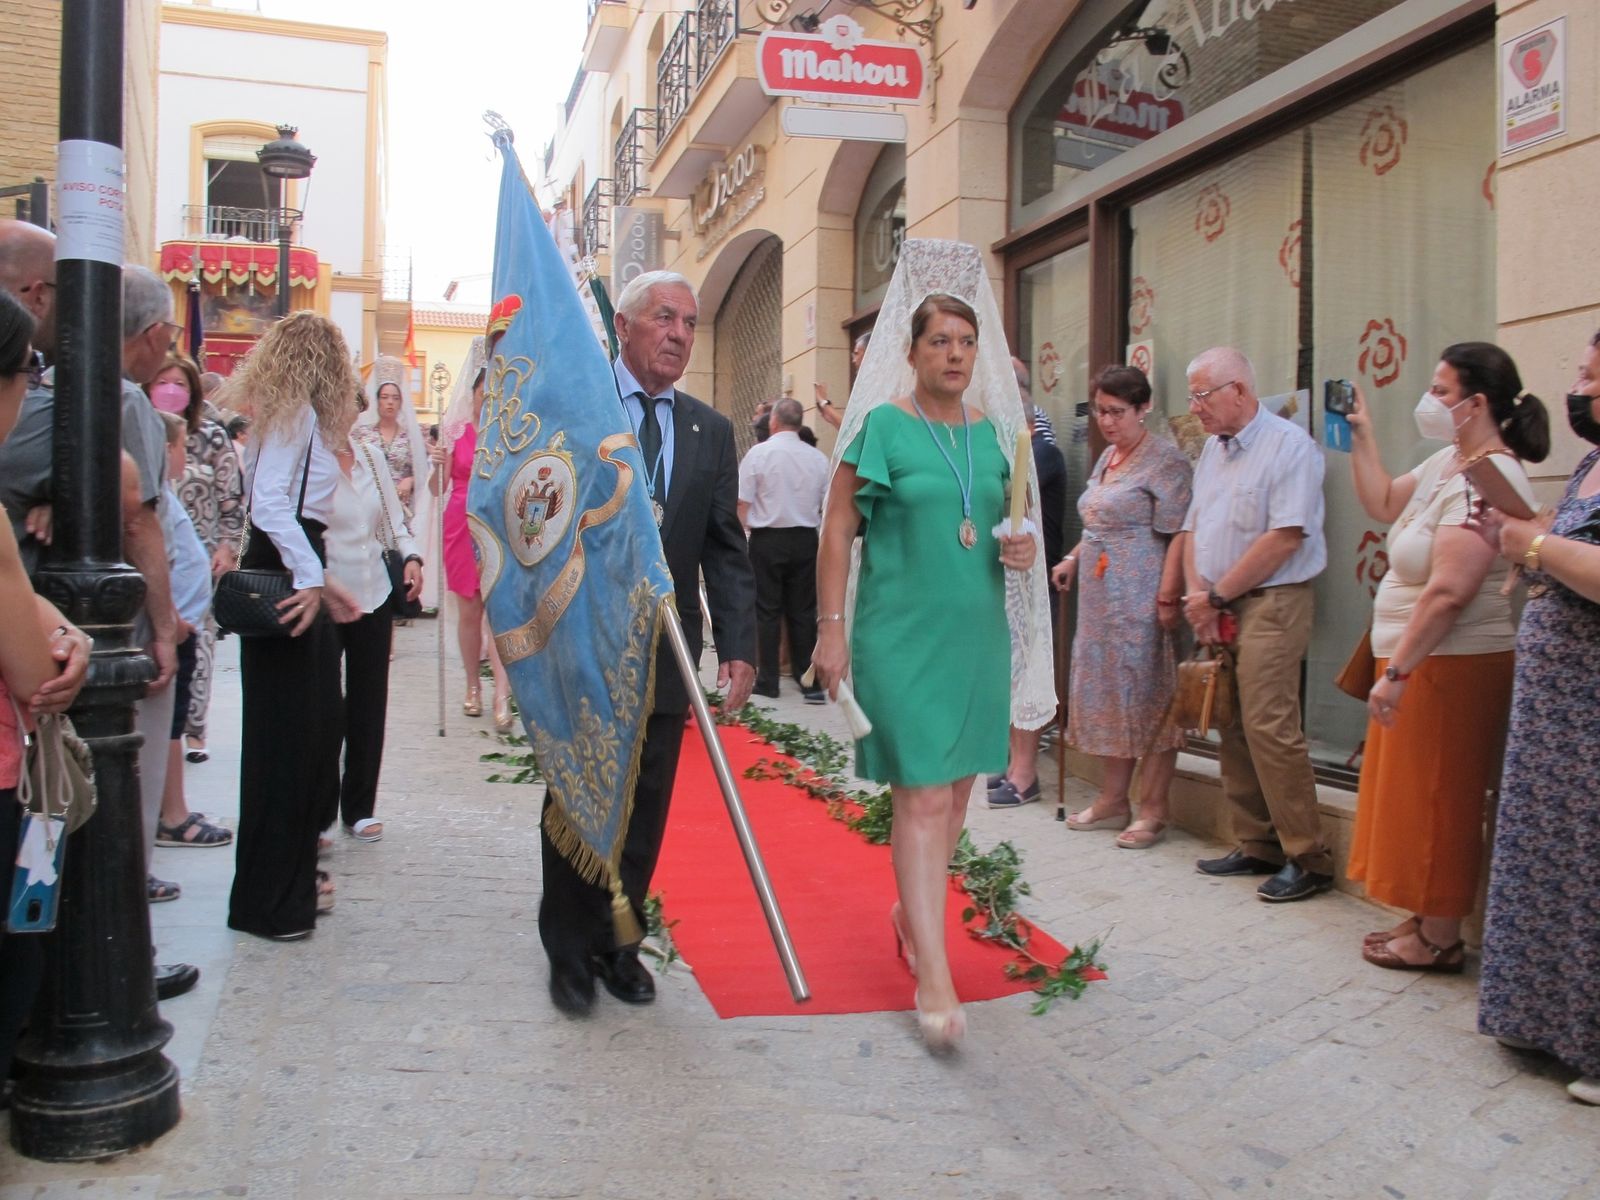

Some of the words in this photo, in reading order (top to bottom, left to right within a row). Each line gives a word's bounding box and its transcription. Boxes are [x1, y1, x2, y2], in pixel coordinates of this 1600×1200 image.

[778, 48, 910, 87] Mahou
[1507, 81, 1560, 111] ALARMA
[62, 182, 96, 192] AVISO
